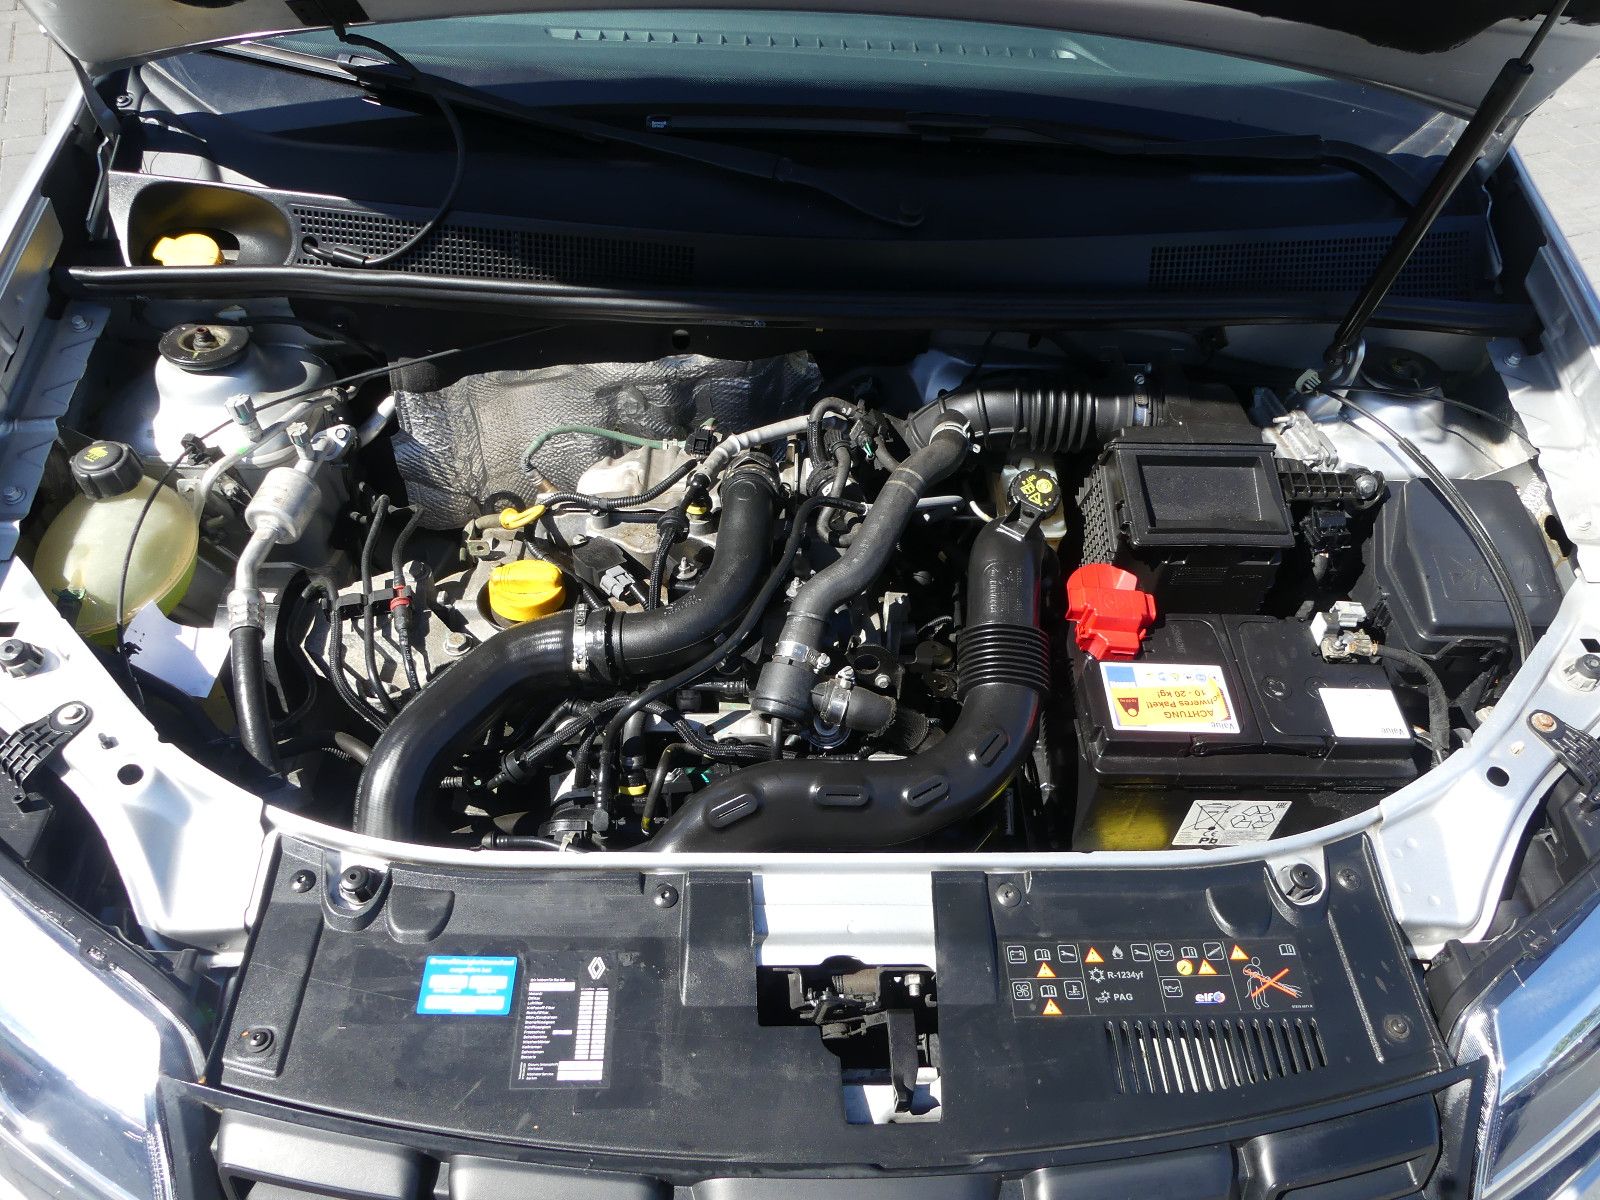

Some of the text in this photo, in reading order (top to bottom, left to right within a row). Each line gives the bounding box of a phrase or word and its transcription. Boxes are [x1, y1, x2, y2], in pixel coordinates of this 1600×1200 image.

[1156, 689, 1172, 698] kg!
[1174, 690, 1185, 698] 20
[1194, 689, 1206, 697] 10
[1145, 694, 1220, 709] chweres Paket!
[1163, 709, 1214, 719] ACHTUNG
[1211, 721, 1235, 730] Value
[1107, 971, 1144, 981] R-1234yf
[1113, 992, 1133, 1001] PAG
[1195, 992, 1214, 1002] elf
